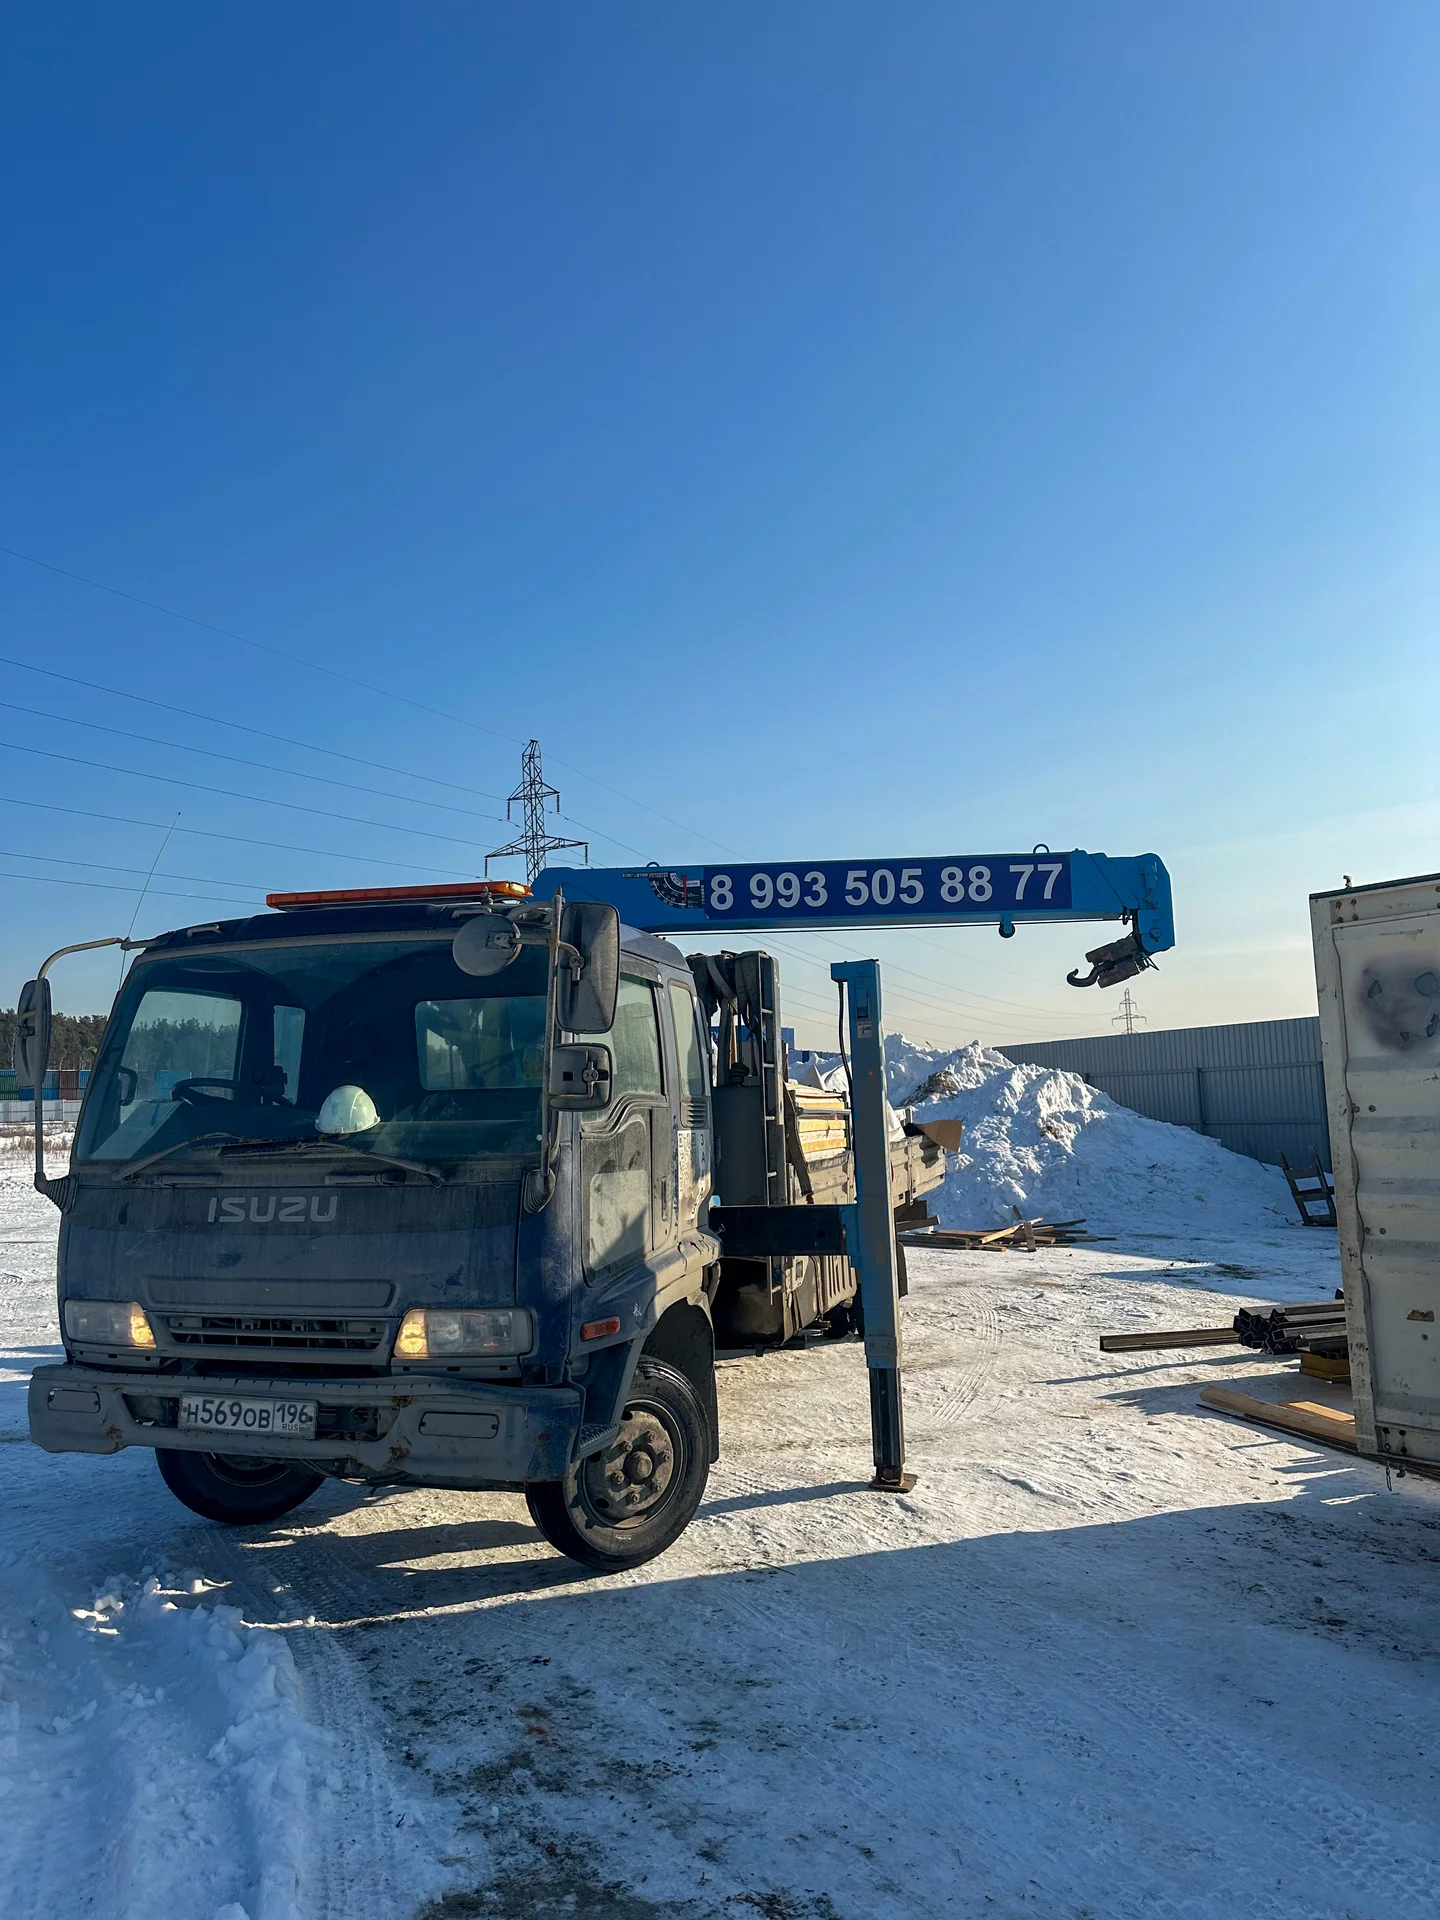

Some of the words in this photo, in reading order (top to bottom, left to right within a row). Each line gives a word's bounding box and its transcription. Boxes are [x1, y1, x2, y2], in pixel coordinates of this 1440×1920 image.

[709, 873, 734, 911] 8
[749, 870, 828, 910] 993
[844, 867, 924, 906] 505
[939, 864, 993, 903] 88
[1009, 862, 1064, 901] 77
[207, 1195, 338, 1223] ISUZU
[187, 1399, 271, 1429] Н569ОВ
[276, 1403, 310, 1424] 196
[281, 1423, 299, 1432] RUS
